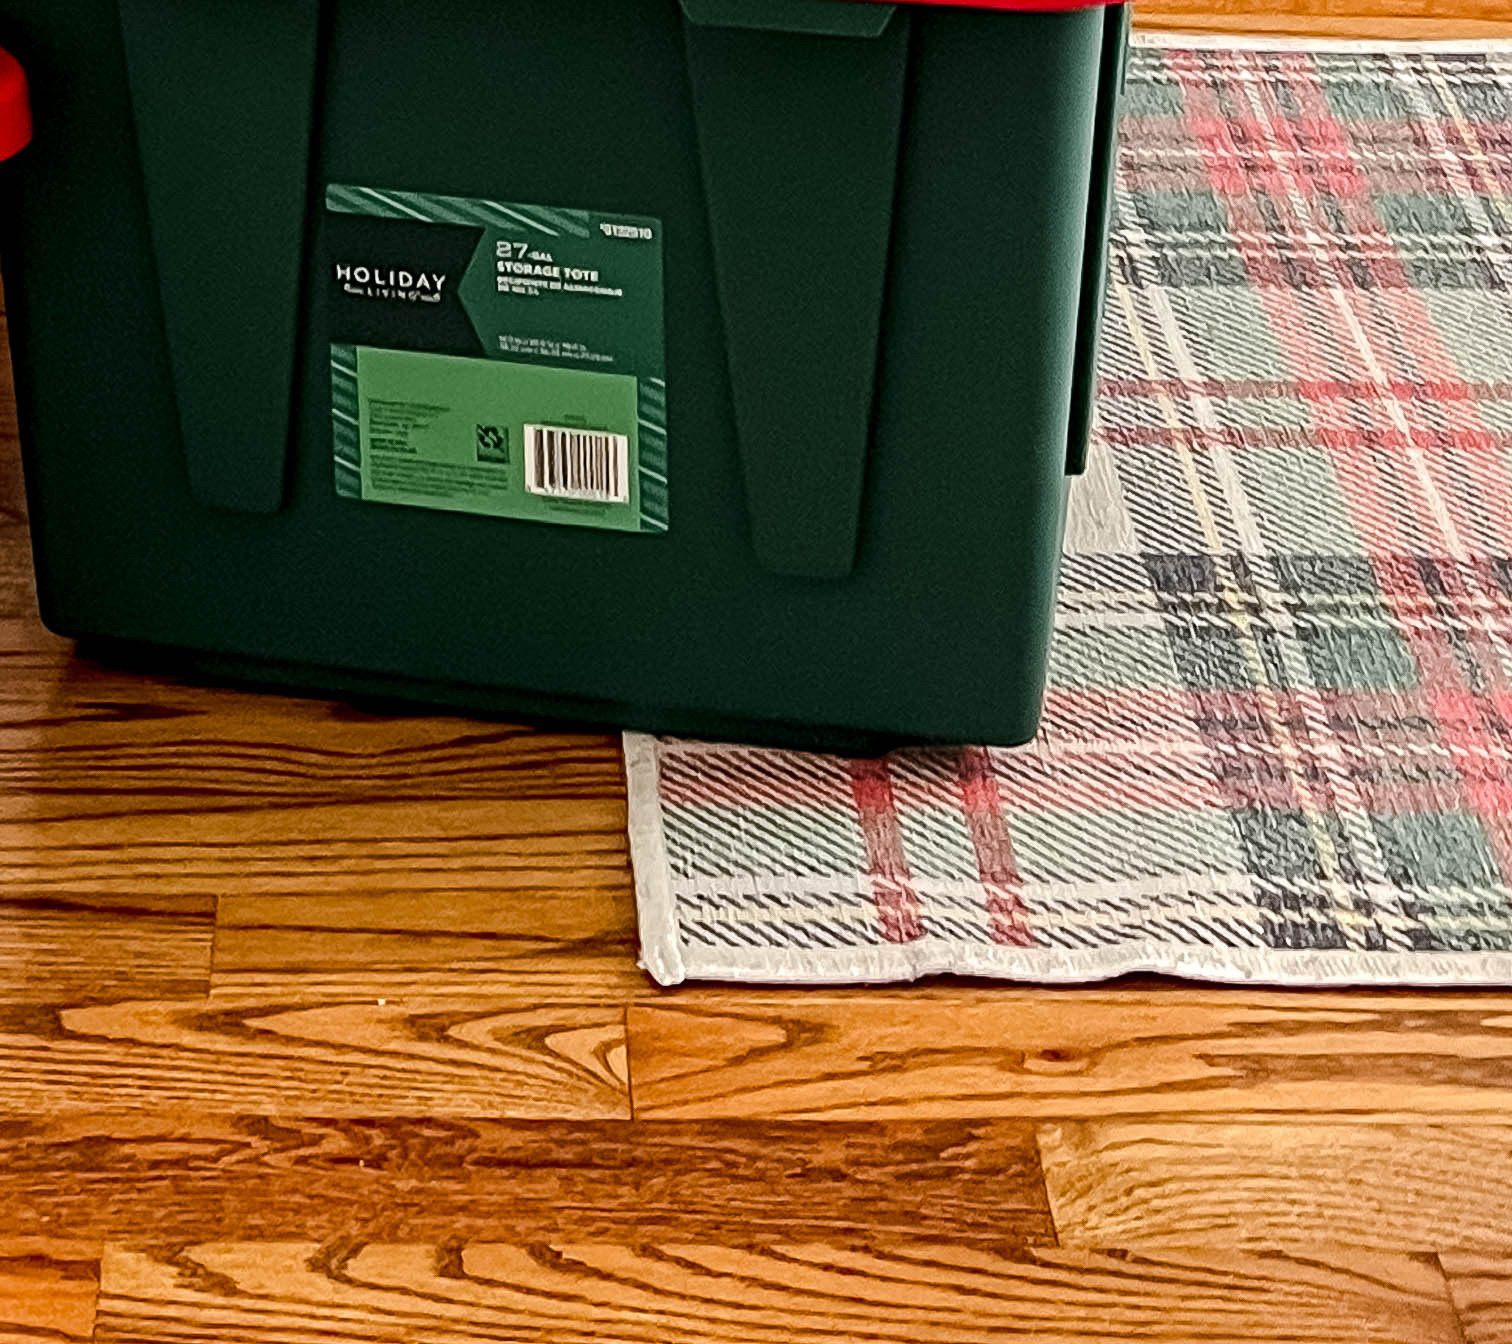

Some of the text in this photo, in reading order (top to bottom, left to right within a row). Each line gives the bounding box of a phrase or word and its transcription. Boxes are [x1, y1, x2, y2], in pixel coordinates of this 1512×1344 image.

[336, 263, 448, 292] HOLIDAY
[496, 260, 600, 283] STORAGE TOTE
